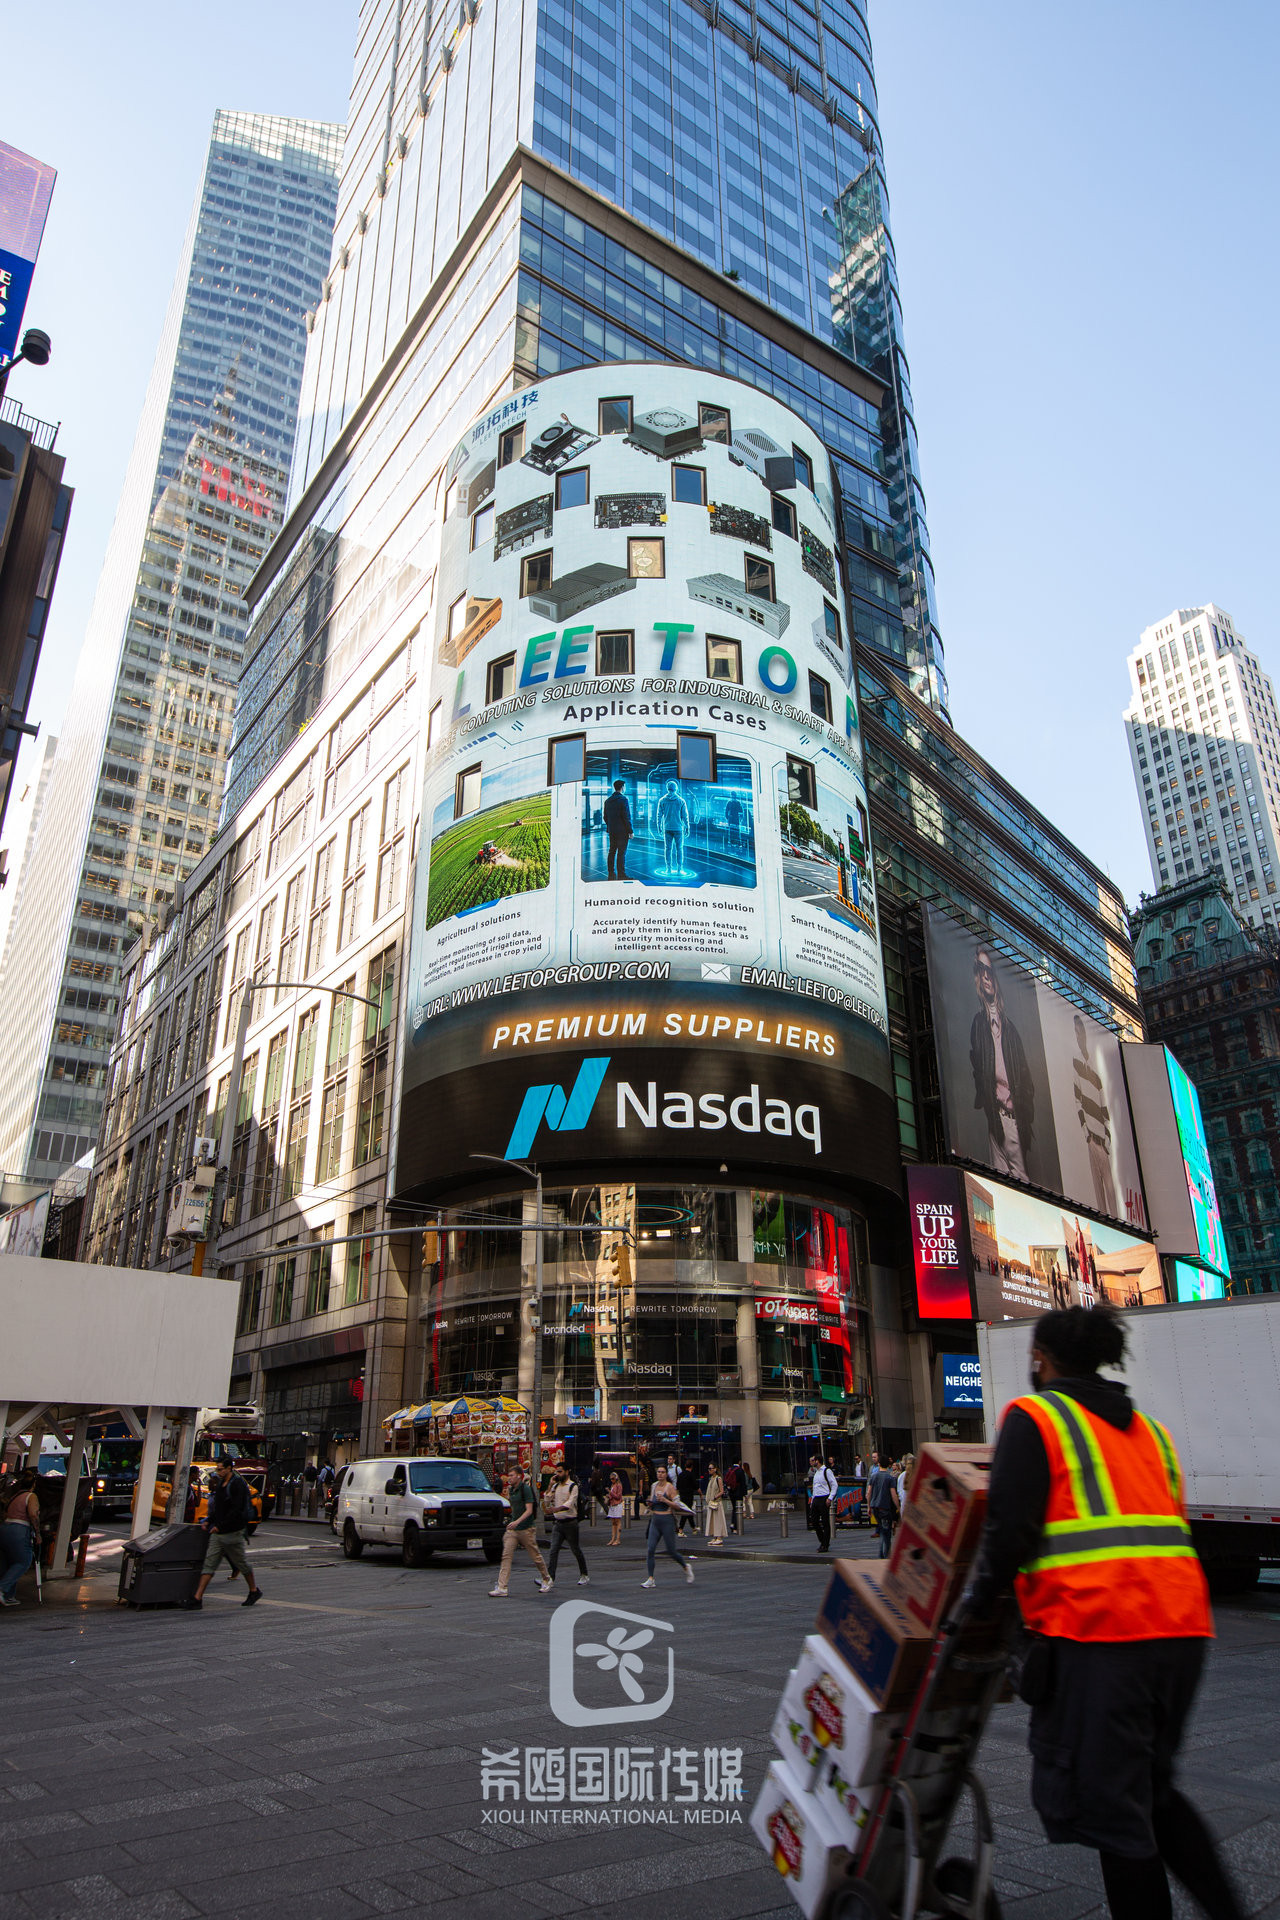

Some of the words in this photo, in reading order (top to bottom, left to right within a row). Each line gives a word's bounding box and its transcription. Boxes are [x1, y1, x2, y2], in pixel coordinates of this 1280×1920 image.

[480, 411, 527, 446] LEETOPTECH
[460, 692, 537, 736] COMPUTING
[542, 678, 635, 703] SOLUTIONS
[641, 678, 677, 693] FOR
[679, 679, 769, 710] INDUSTRIAL
[772, 700, 783, 714] &
[784, 704, 825, 734] SMART
[563, 700, 699, 722] Application
[708, 705, 767, 731] Cases
[584, 897, 641, 907] Humanoid
[645, 897, 708, 909] recognition
[712, 901, 755, 913] solution
[437, 922, 478, 947] Agricultural
[481, 912, 521, 928] solutions
[591, 927, 608, 935] and
[611, 927, 635, 936] apply
[675, 928, 716, 936] scenarios
[718, 930, 738, 939] such
[593, 918, 640, 927] Accurately
[643, 918, 678, 927] identify
[680, 919, 710, 928] human
[713, 921, 747, 932] features
[791, 914, 815, 929] Smart
[817, 924, 862, 952] transportation
[428, 953, 451, 969] Real-time
[452, 940, 487, 959] monitoring
[488, 936, 496, 945] of
[498, 933, 511, 942] soil
[512, 929, 532, 939] data,
[614, 944, 661, 953] intelligent
[695, 946, 729, 954] control.
[617, 935, 652, 944] security
[655, 936, 705, 945] monitoring
[804, 938, 833, 954] Integrate
[834, 949, 846, 960] road
[449, 950, 480, 968] regulation
[481, 947, 489, 955] of
[490, 938, 525, 953] irrigation
[527, 935, 542, 943] and
[453, 963, 465, 973] and
[466, 955, 493, 968] increase
[495, 951, 501, 959] in
[504, 948, 521, 959] crop
[523, 943, 542, 955] yield
[801, 947, 826, 961] parking
[827, 954, 859, 976] management
[795, 953, 823, 966] enhance
[824, 960, 842, 974] traffic
[426, 995, 450, 1019] URL:
[451, 961, 671, 1008] WWW.LEETOPGROUP.COM
[740, 965, 796, 993] EMAIL:
[492, 1013, 647, 1049] PREMIUM
[663, 1013, 836, 1056] SUPPLIERS
[616, 1081, 822, 1154] Nasdaq
[916, 1203, 953, 1216] SPAIN
[917, 1215, 955, 1237] UP
[919, 1237, 957, 1249] YOUR
[920, 1249, 959, 1264] LIFE
[1001, 1291, 1013, 1301] YOUR
[1012, 1294, 1021, 1303] LIFE
[1026, 1297, 1034, 1306] THE
[477, 1311, 513, 1322] TOMORROW
[583, 1304, 615, 1316] Nasdaq
[630, 1305, 667, 1313] REWRITE
[670, 1306, 718, 1314] TOMORROW
[628, 1362, 673, 1377] Nasdaq
